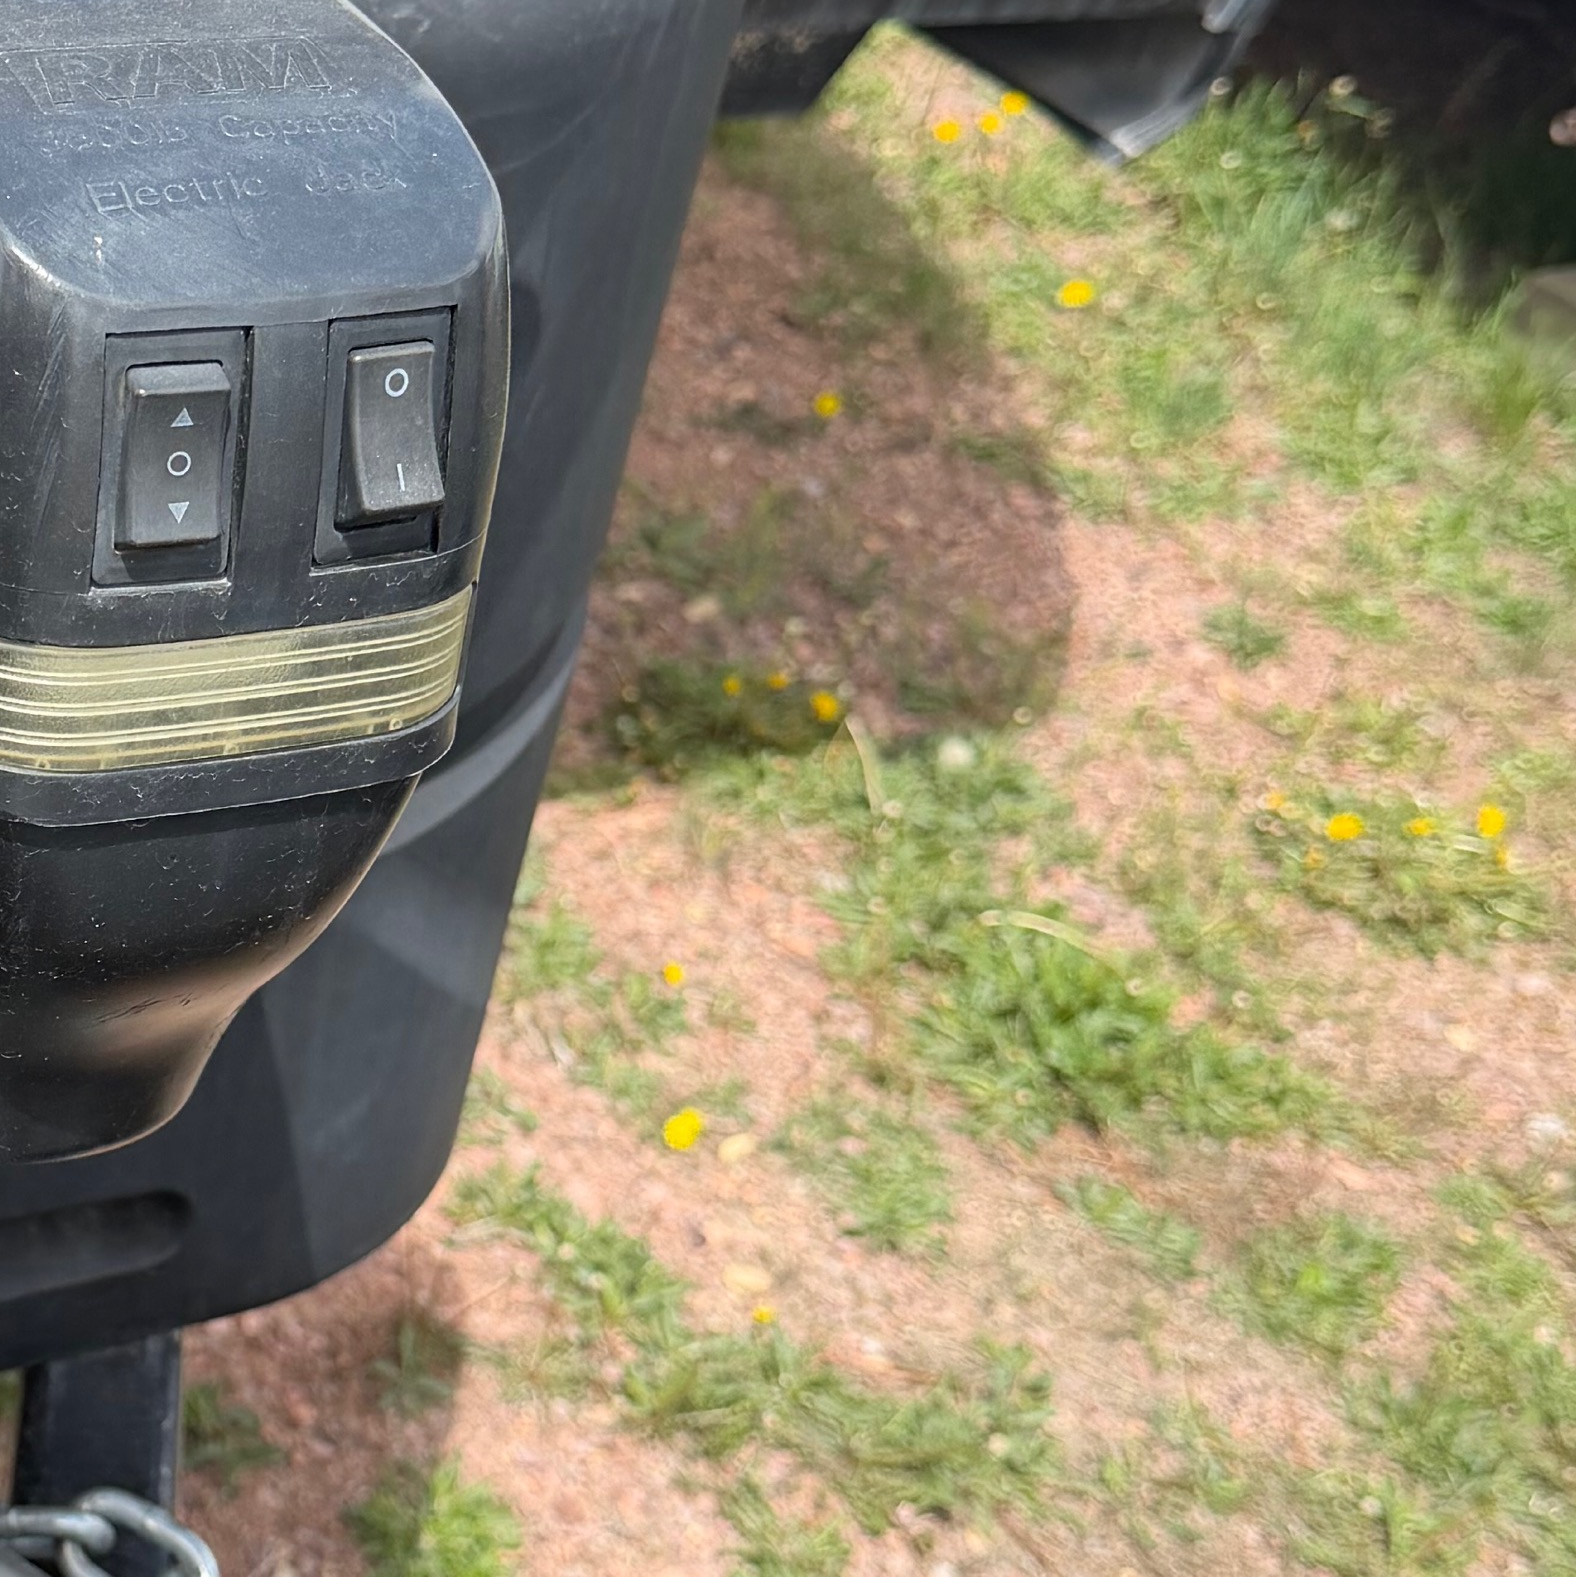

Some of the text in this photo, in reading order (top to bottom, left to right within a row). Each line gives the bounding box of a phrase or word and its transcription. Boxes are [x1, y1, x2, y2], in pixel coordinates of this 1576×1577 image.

[35, 41, 331, 106] RAM
[219, 109, 398, 147] Capacity
[86, 166, 407, 213] Electric Jack
